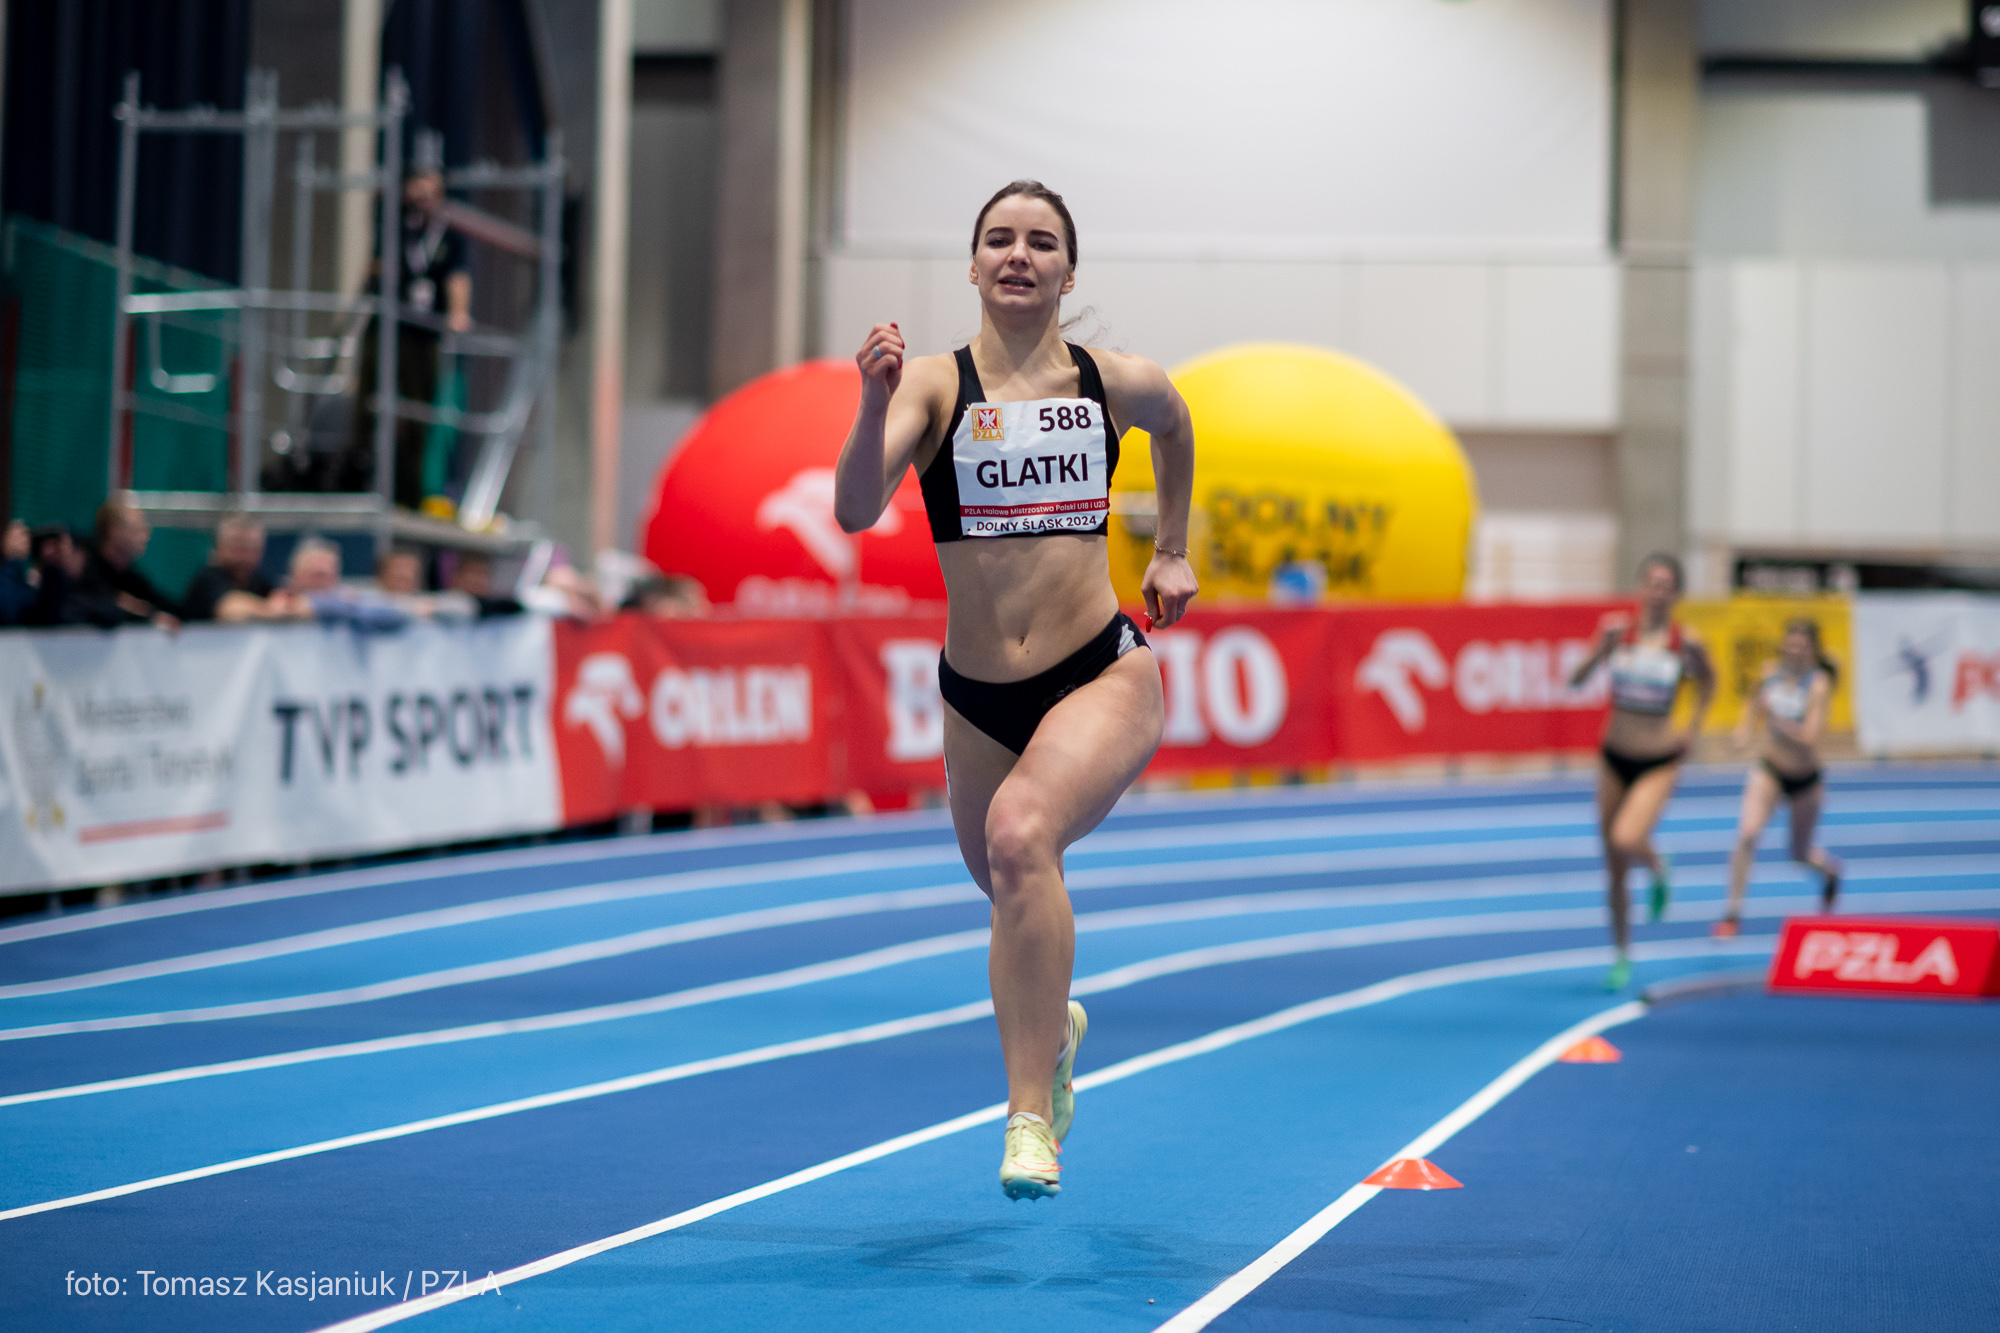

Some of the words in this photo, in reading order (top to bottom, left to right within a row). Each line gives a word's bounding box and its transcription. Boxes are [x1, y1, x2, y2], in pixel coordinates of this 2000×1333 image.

[1039, 405, 1091, 432] 588
[974, 429, 1003, 440] PZLA
[976, 453, 1088, 488] GLATKI
[964, 507, 982, 515] PZLA
[983, 508, 1009, 516] Halowe
[1010, 505, 1055, 516] Mistrzostwa
[1055, 503, 1076, 512] Polski
[1077, 501, 1089, 510] U18
[1093, 500, 1106, 508] U20
[976, 521, 1018, 532] DOLNY
[1022, 517, 1063, 532] ŚLĄSK
[1066, 515, 1097, 527] 2024
[650, 664, 813, 749] ORLEN
[273, 698, 373, 786] TVP
[386, 684, 536, 773] SPORT
[1794, 930, 1958, 985] PZLA
